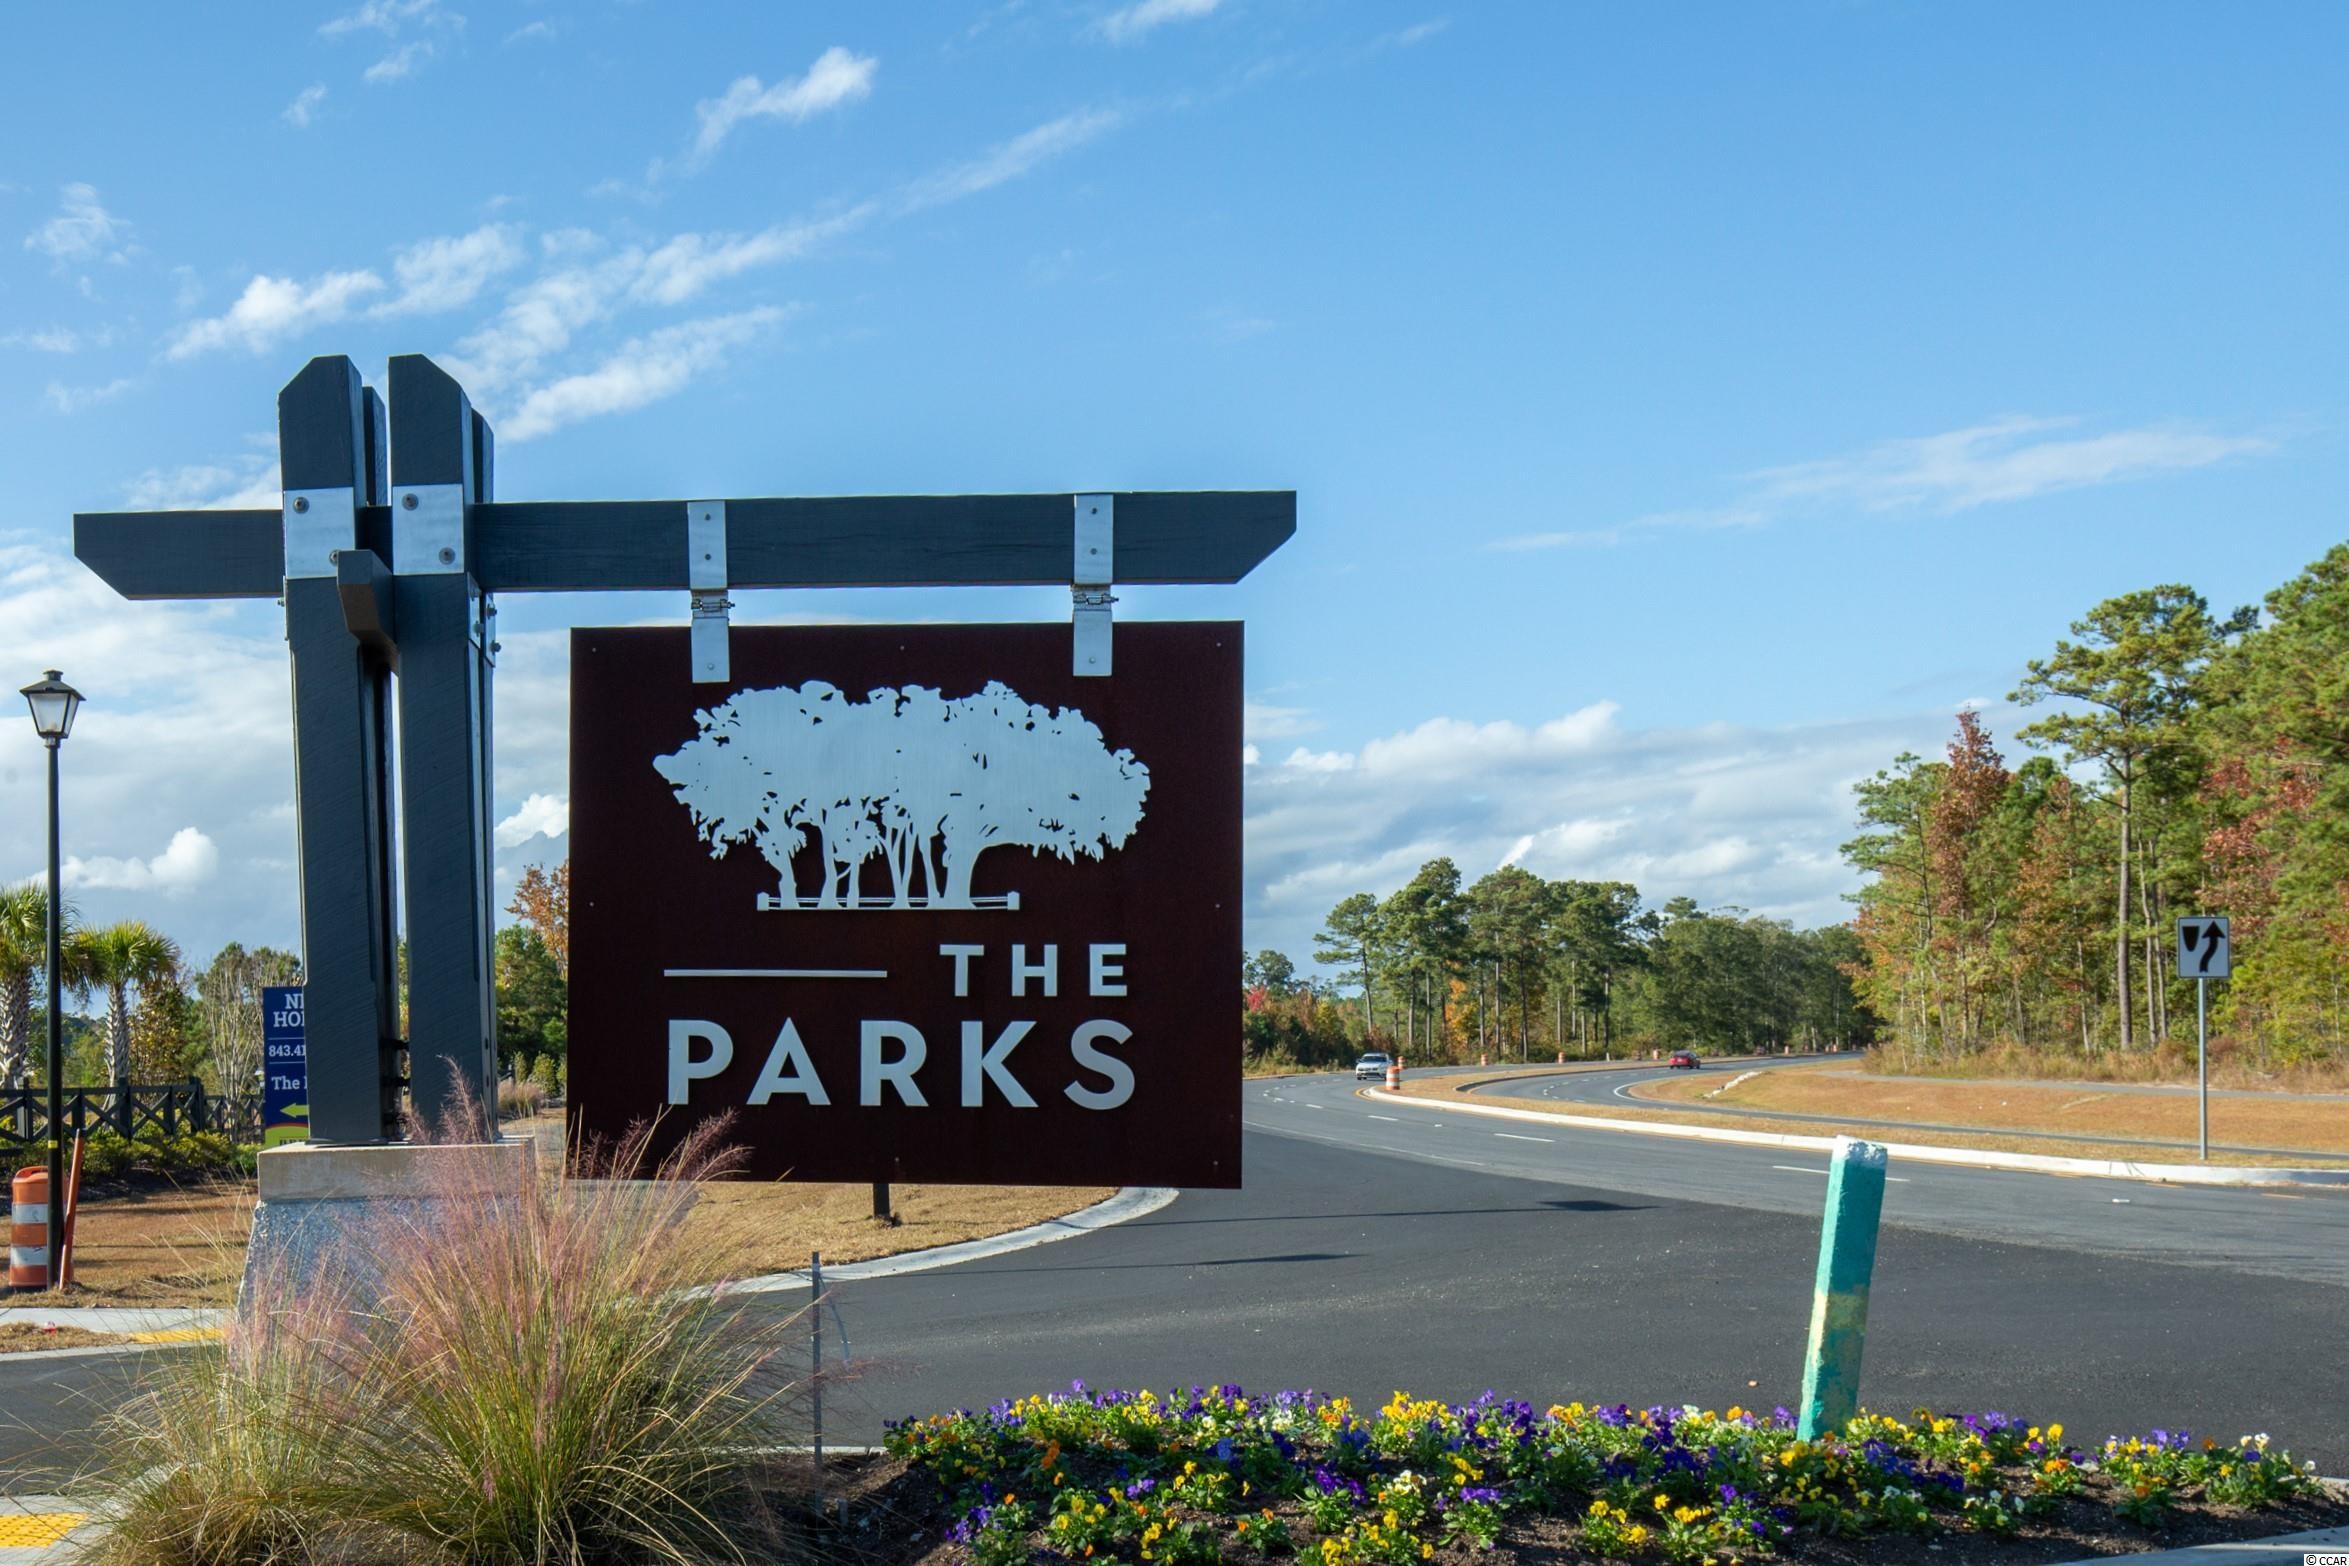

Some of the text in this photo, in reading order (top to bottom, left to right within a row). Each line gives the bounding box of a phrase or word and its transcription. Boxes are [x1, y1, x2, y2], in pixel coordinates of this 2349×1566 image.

[939, 943, 1128, 997] THE
[273, 1011, 304, 1027] HO
[668, 1017, 1136, 1111] PARKS
[271, 1075, 300, 1090] The
